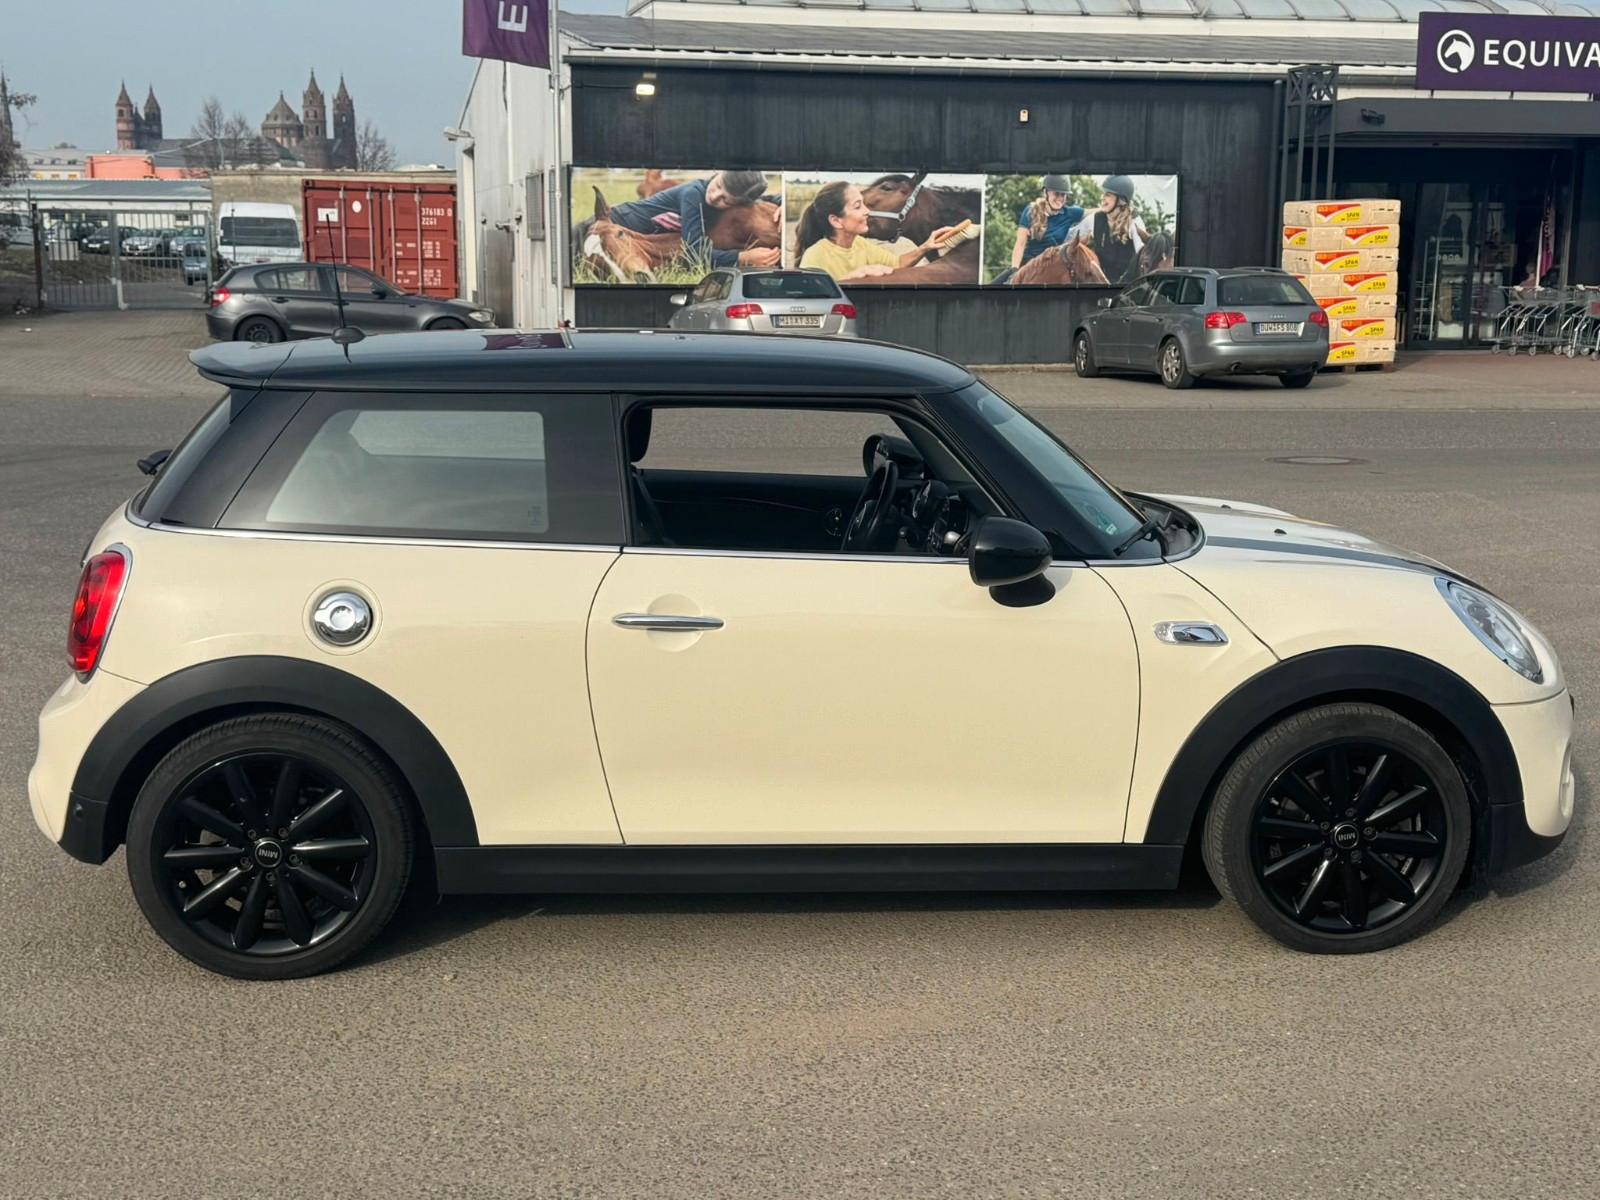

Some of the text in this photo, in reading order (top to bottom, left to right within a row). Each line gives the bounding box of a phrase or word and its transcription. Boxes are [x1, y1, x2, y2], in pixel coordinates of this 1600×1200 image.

[497, 0, 528, 33] E
[1483, 39, 1600, 70] EQUIVA
[258, 848, 278, 859] MINI
